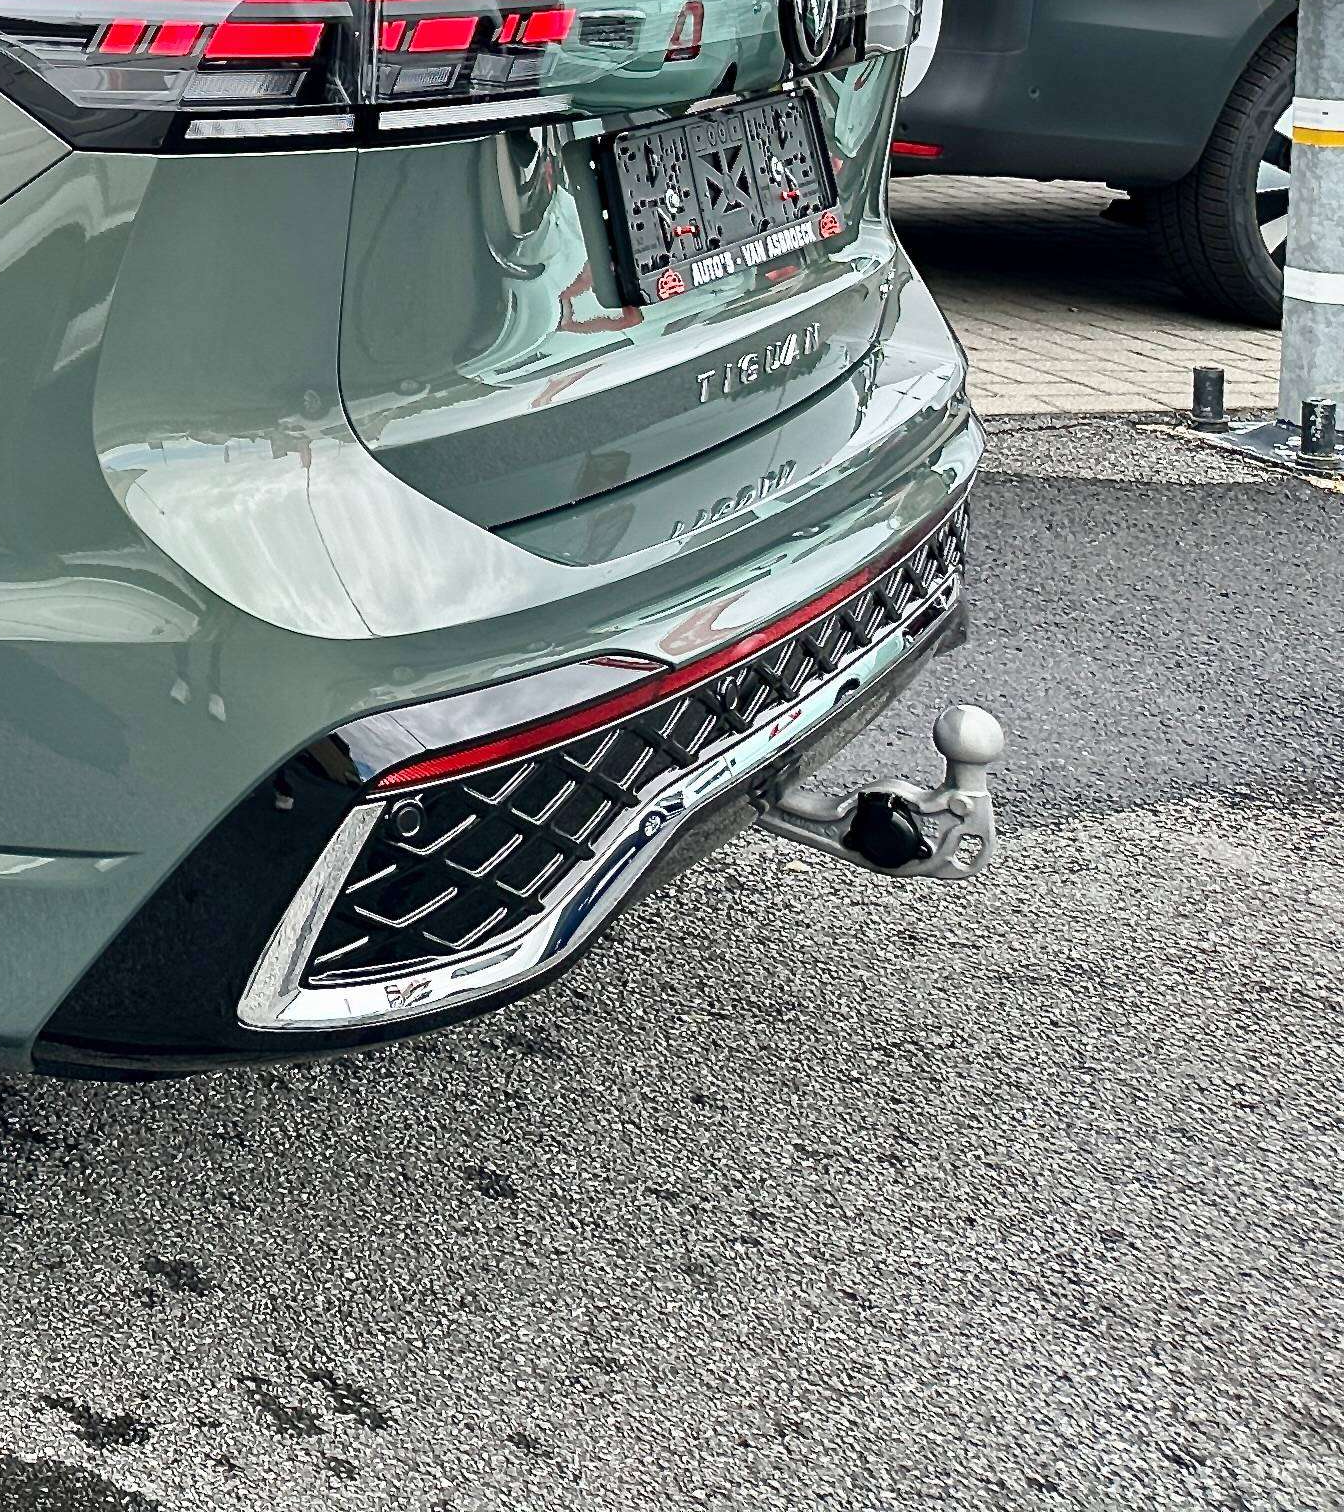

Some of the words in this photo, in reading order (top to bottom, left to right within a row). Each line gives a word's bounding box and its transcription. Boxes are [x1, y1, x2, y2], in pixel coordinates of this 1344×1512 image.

[691, 251, 735, 287] AUTO'S
[740, 239, 767, 267] VAN
[697, 322, 820, 403] TIGUAN
